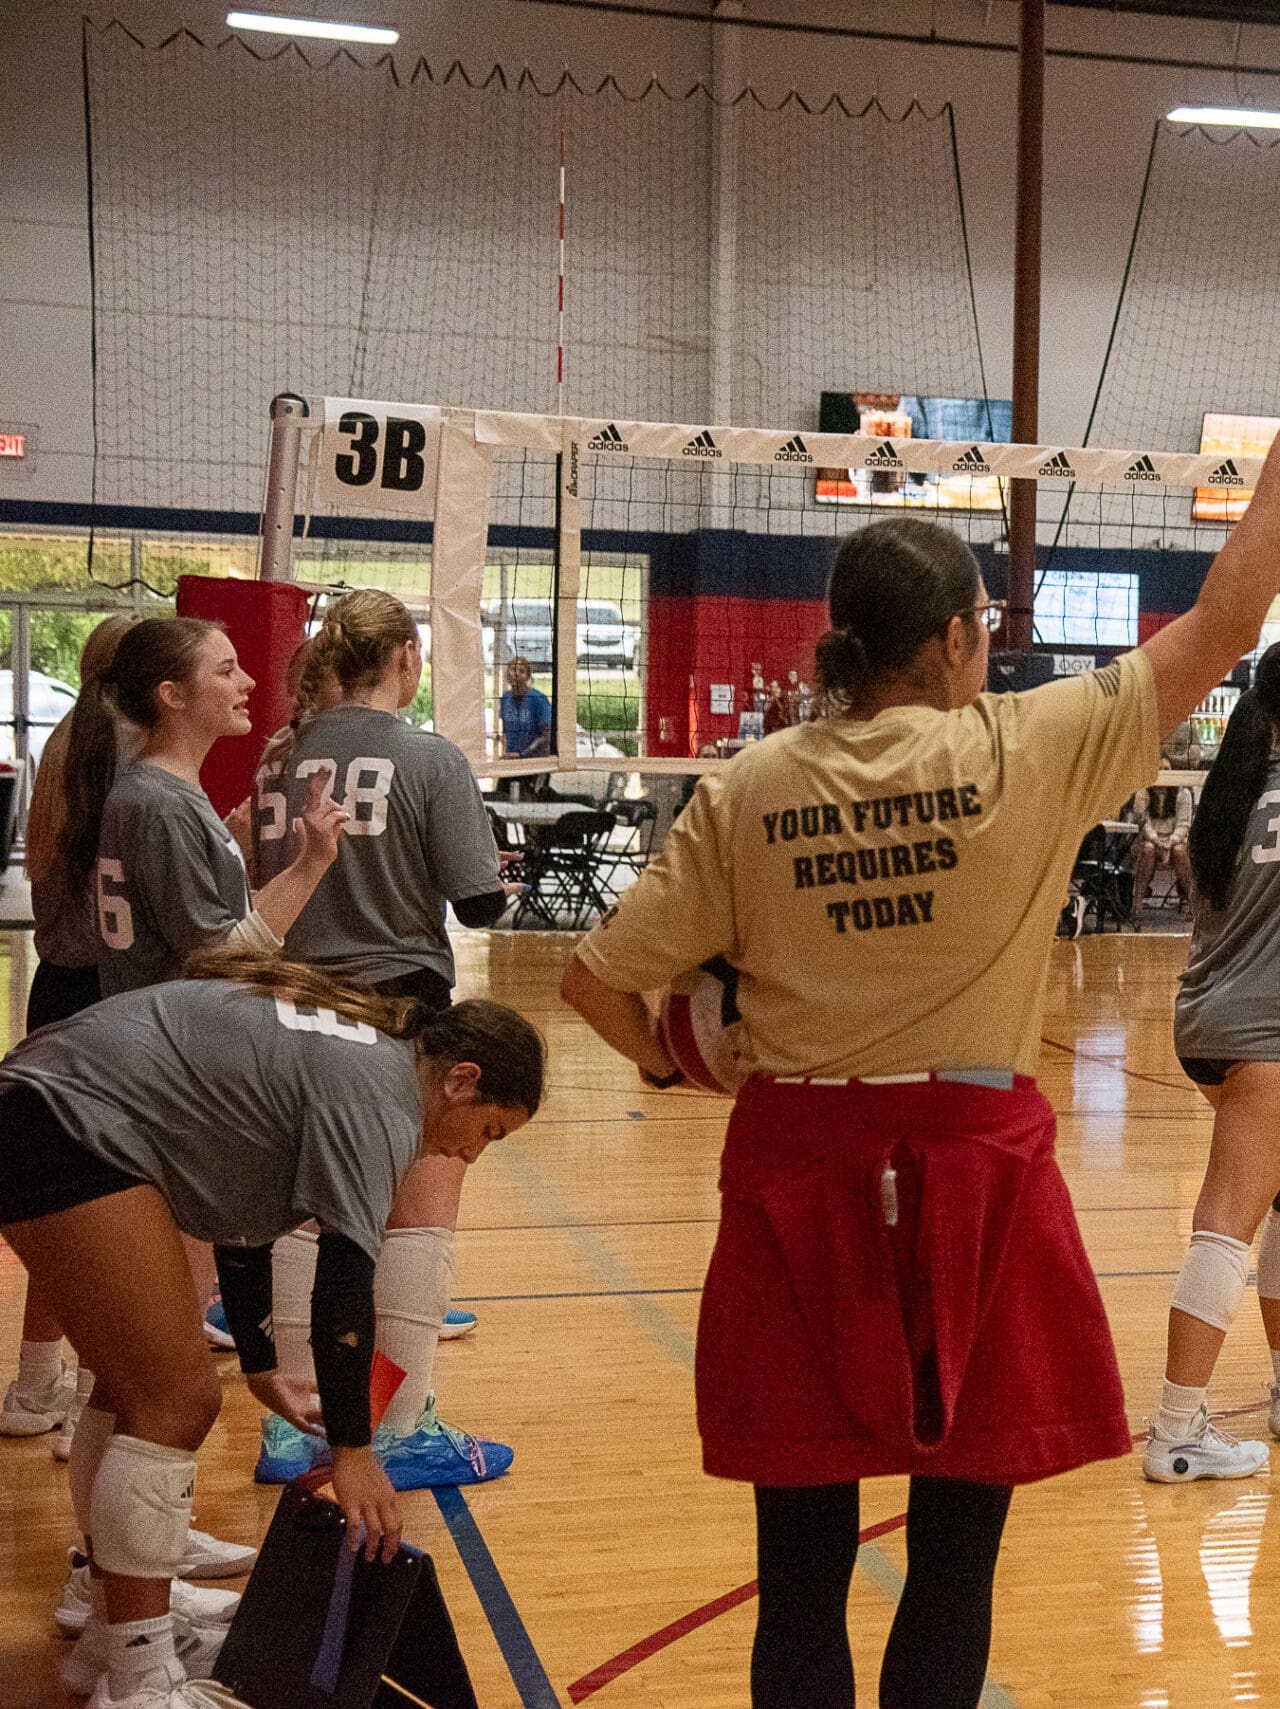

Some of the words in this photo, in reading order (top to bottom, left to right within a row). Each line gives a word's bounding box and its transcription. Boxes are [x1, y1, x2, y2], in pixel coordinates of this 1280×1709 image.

[334, 412, 426, 492] 3B
[587, 441, 629, 453] adidas
[682, 447, 722, 458] adidas
[774, 452, 814, 464] adidas
[864, 457, 904, 468] adidas
[952, 461, 991, 473] adidas
[1038, 466, 1076, 478] adidas
[1123, 470, 1161, 482] adidas
[1208, 474, 1244, 485] adidas
[763, 803, 842, 845] YOUR
[853, 783, 981, 833] FUTURE
[794, 838, 959, 889] REQUIRES
[827, 891, 936, 933] TODAY
